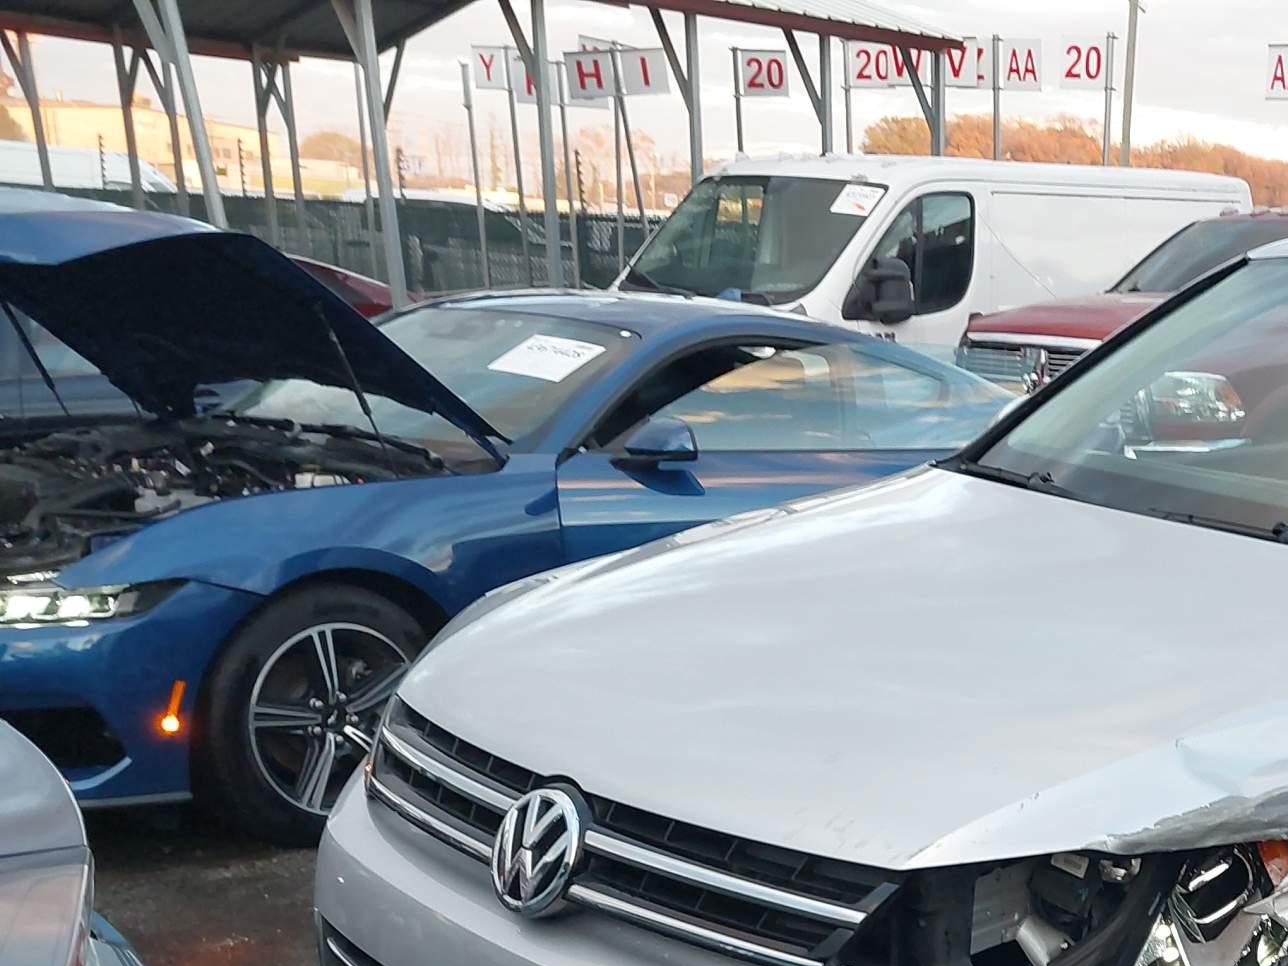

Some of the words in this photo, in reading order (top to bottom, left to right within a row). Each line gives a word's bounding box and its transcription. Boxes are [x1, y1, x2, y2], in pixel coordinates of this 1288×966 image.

[478, 53, 493, 81] Y
[575, 59, 604, 90] H
[639, 56, 651, 87] I
[745, 57, 785, 90] 20
[853, 47, 888, 81] 20
[946, 46, 967, 78] V
[1007, 48, 1038, 81] AA
[1063, 44, 1103, 80] 20
